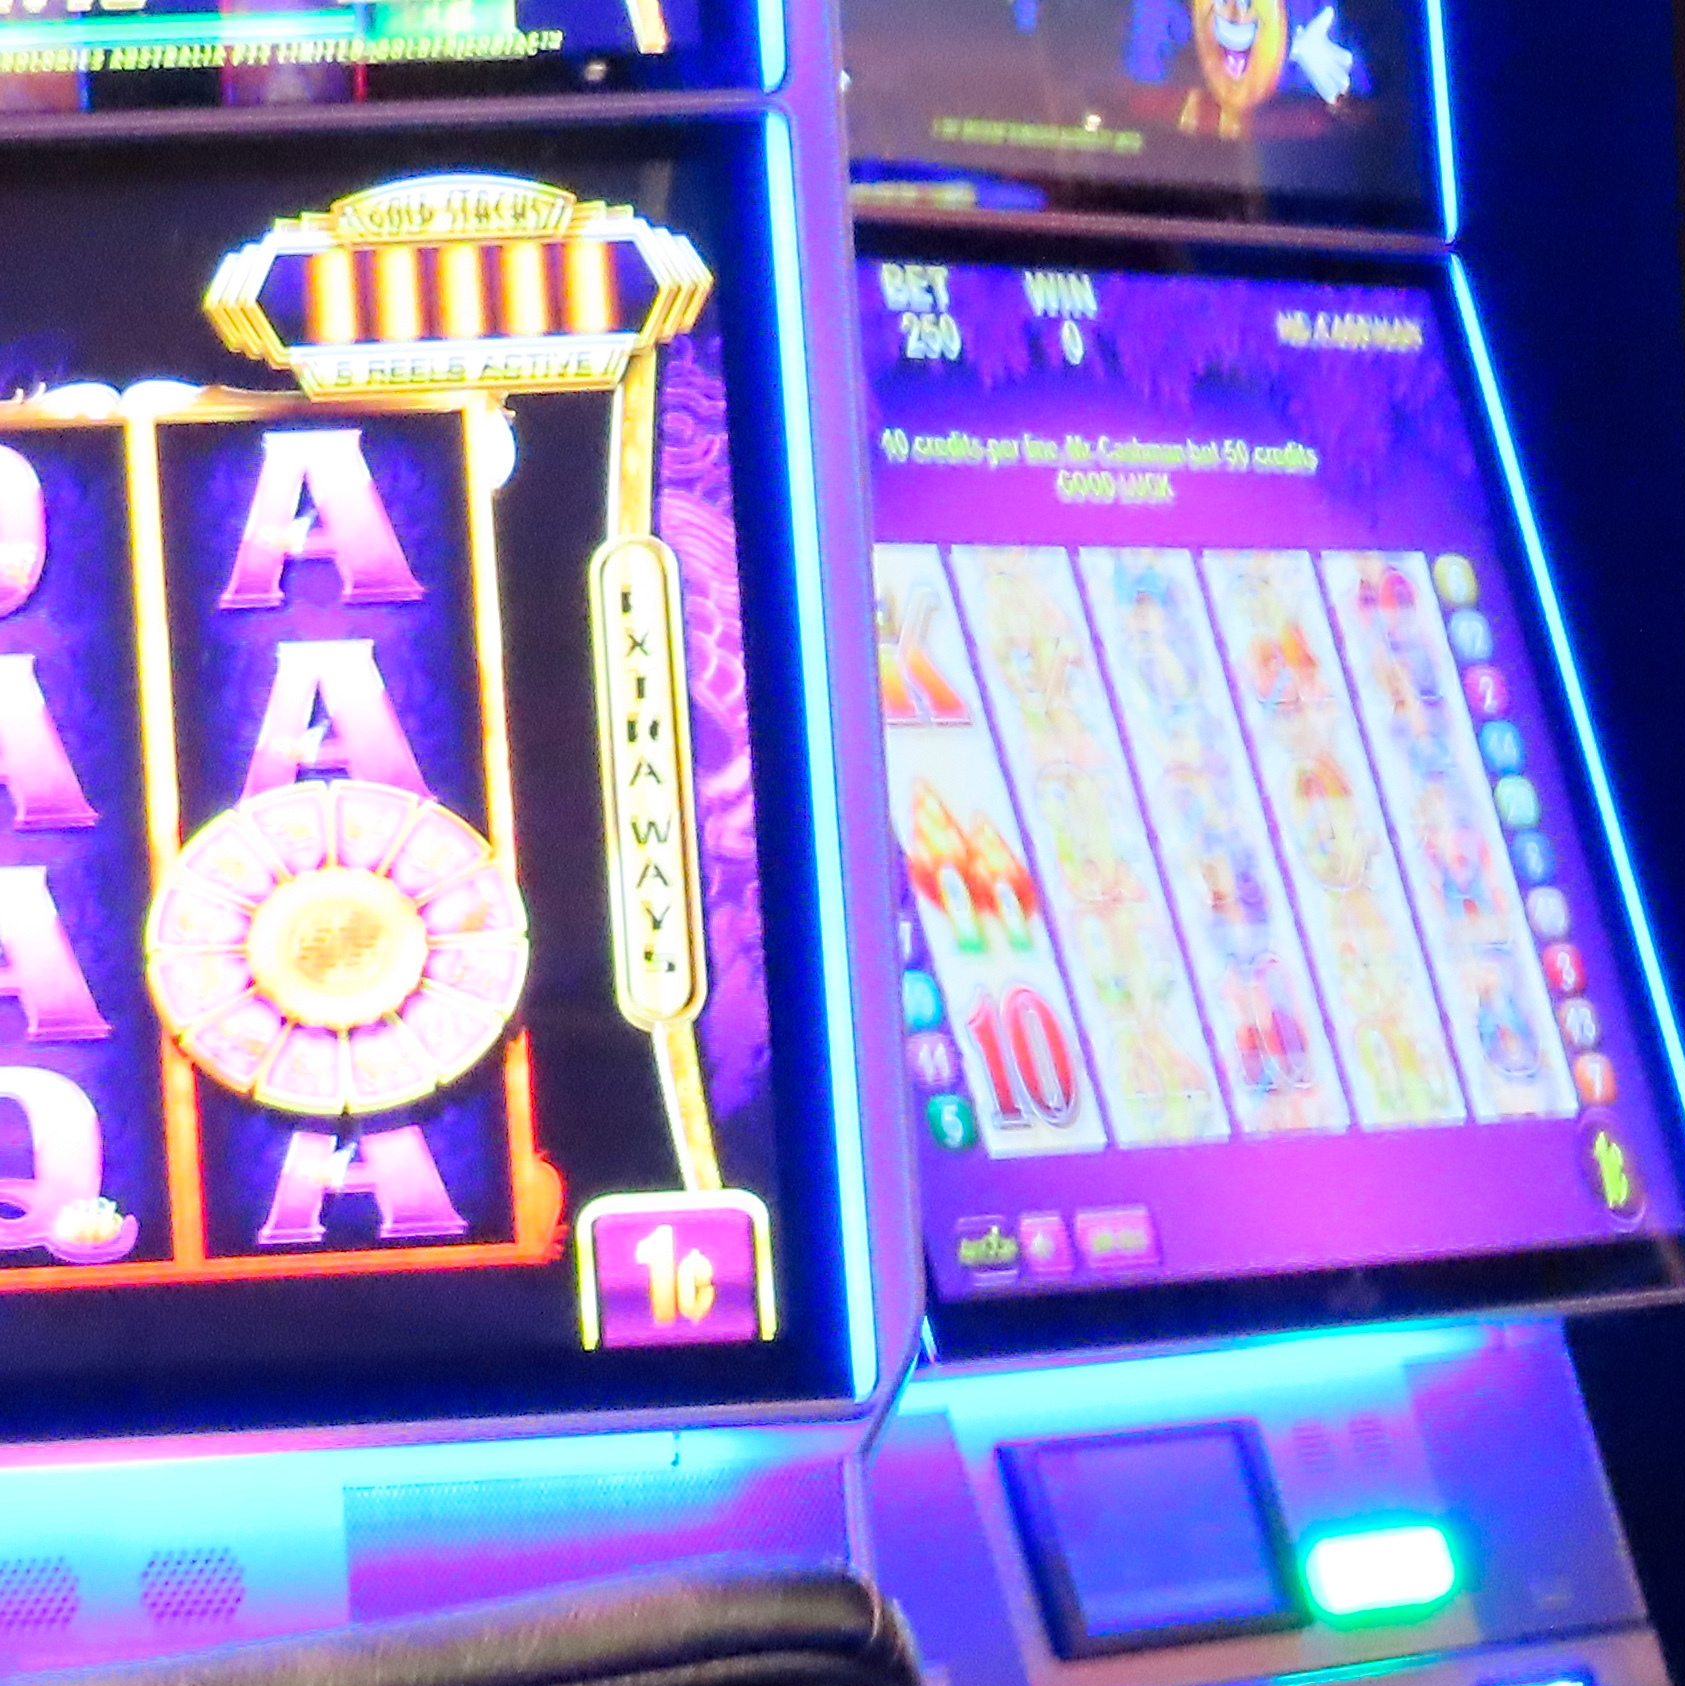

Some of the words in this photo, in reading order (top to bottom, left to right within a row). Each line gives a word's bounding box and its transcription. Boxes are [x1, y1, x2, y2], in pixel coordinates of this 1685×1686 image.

[881, 262, 949, 312] BET
[1022, 269, 1099, 320] WIN
[902, 312, 962, 360] 250
[1060, 318, 1085, 366] 0
[1057, 468, 1117, 503] GOOD
[966, 983, 1082, 1130] 10
